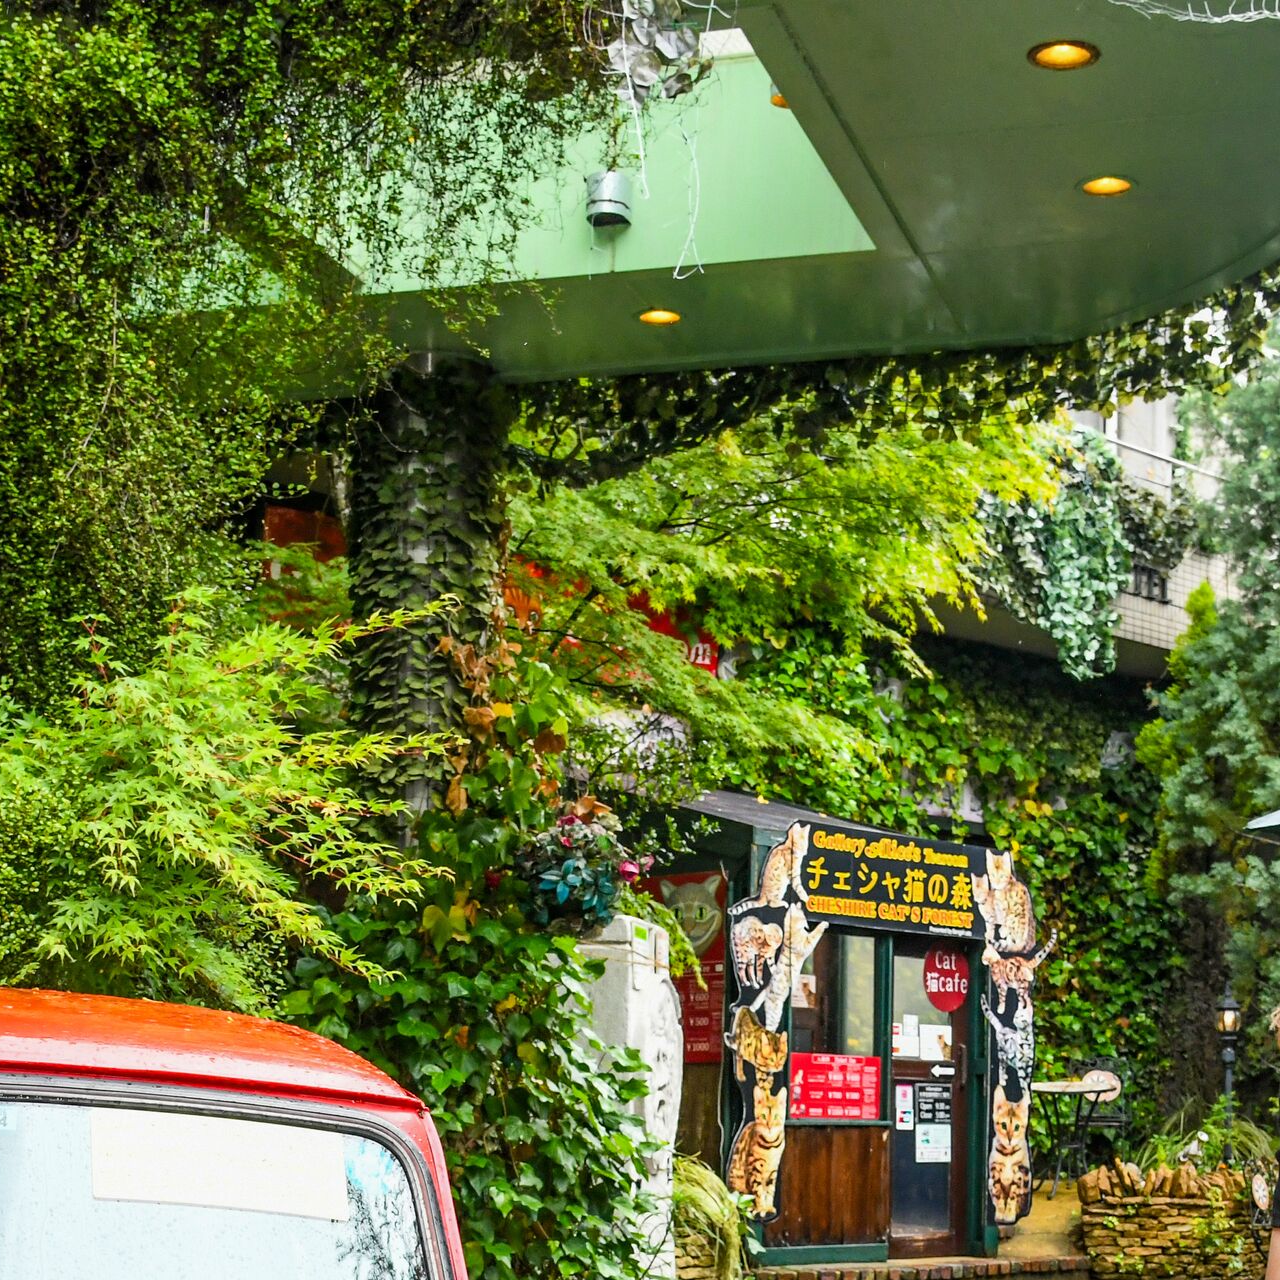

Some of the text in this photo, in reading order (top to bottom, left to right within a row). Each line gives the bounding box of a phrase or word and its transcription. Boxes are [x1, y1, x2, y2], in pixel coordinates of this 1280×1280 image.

[806, 857, 973, 909] チェシャ猫の森
[806, 895, 974, 928] CHESHIRE CAT'S FOREST
[935, 951, 957, 970] Cat
